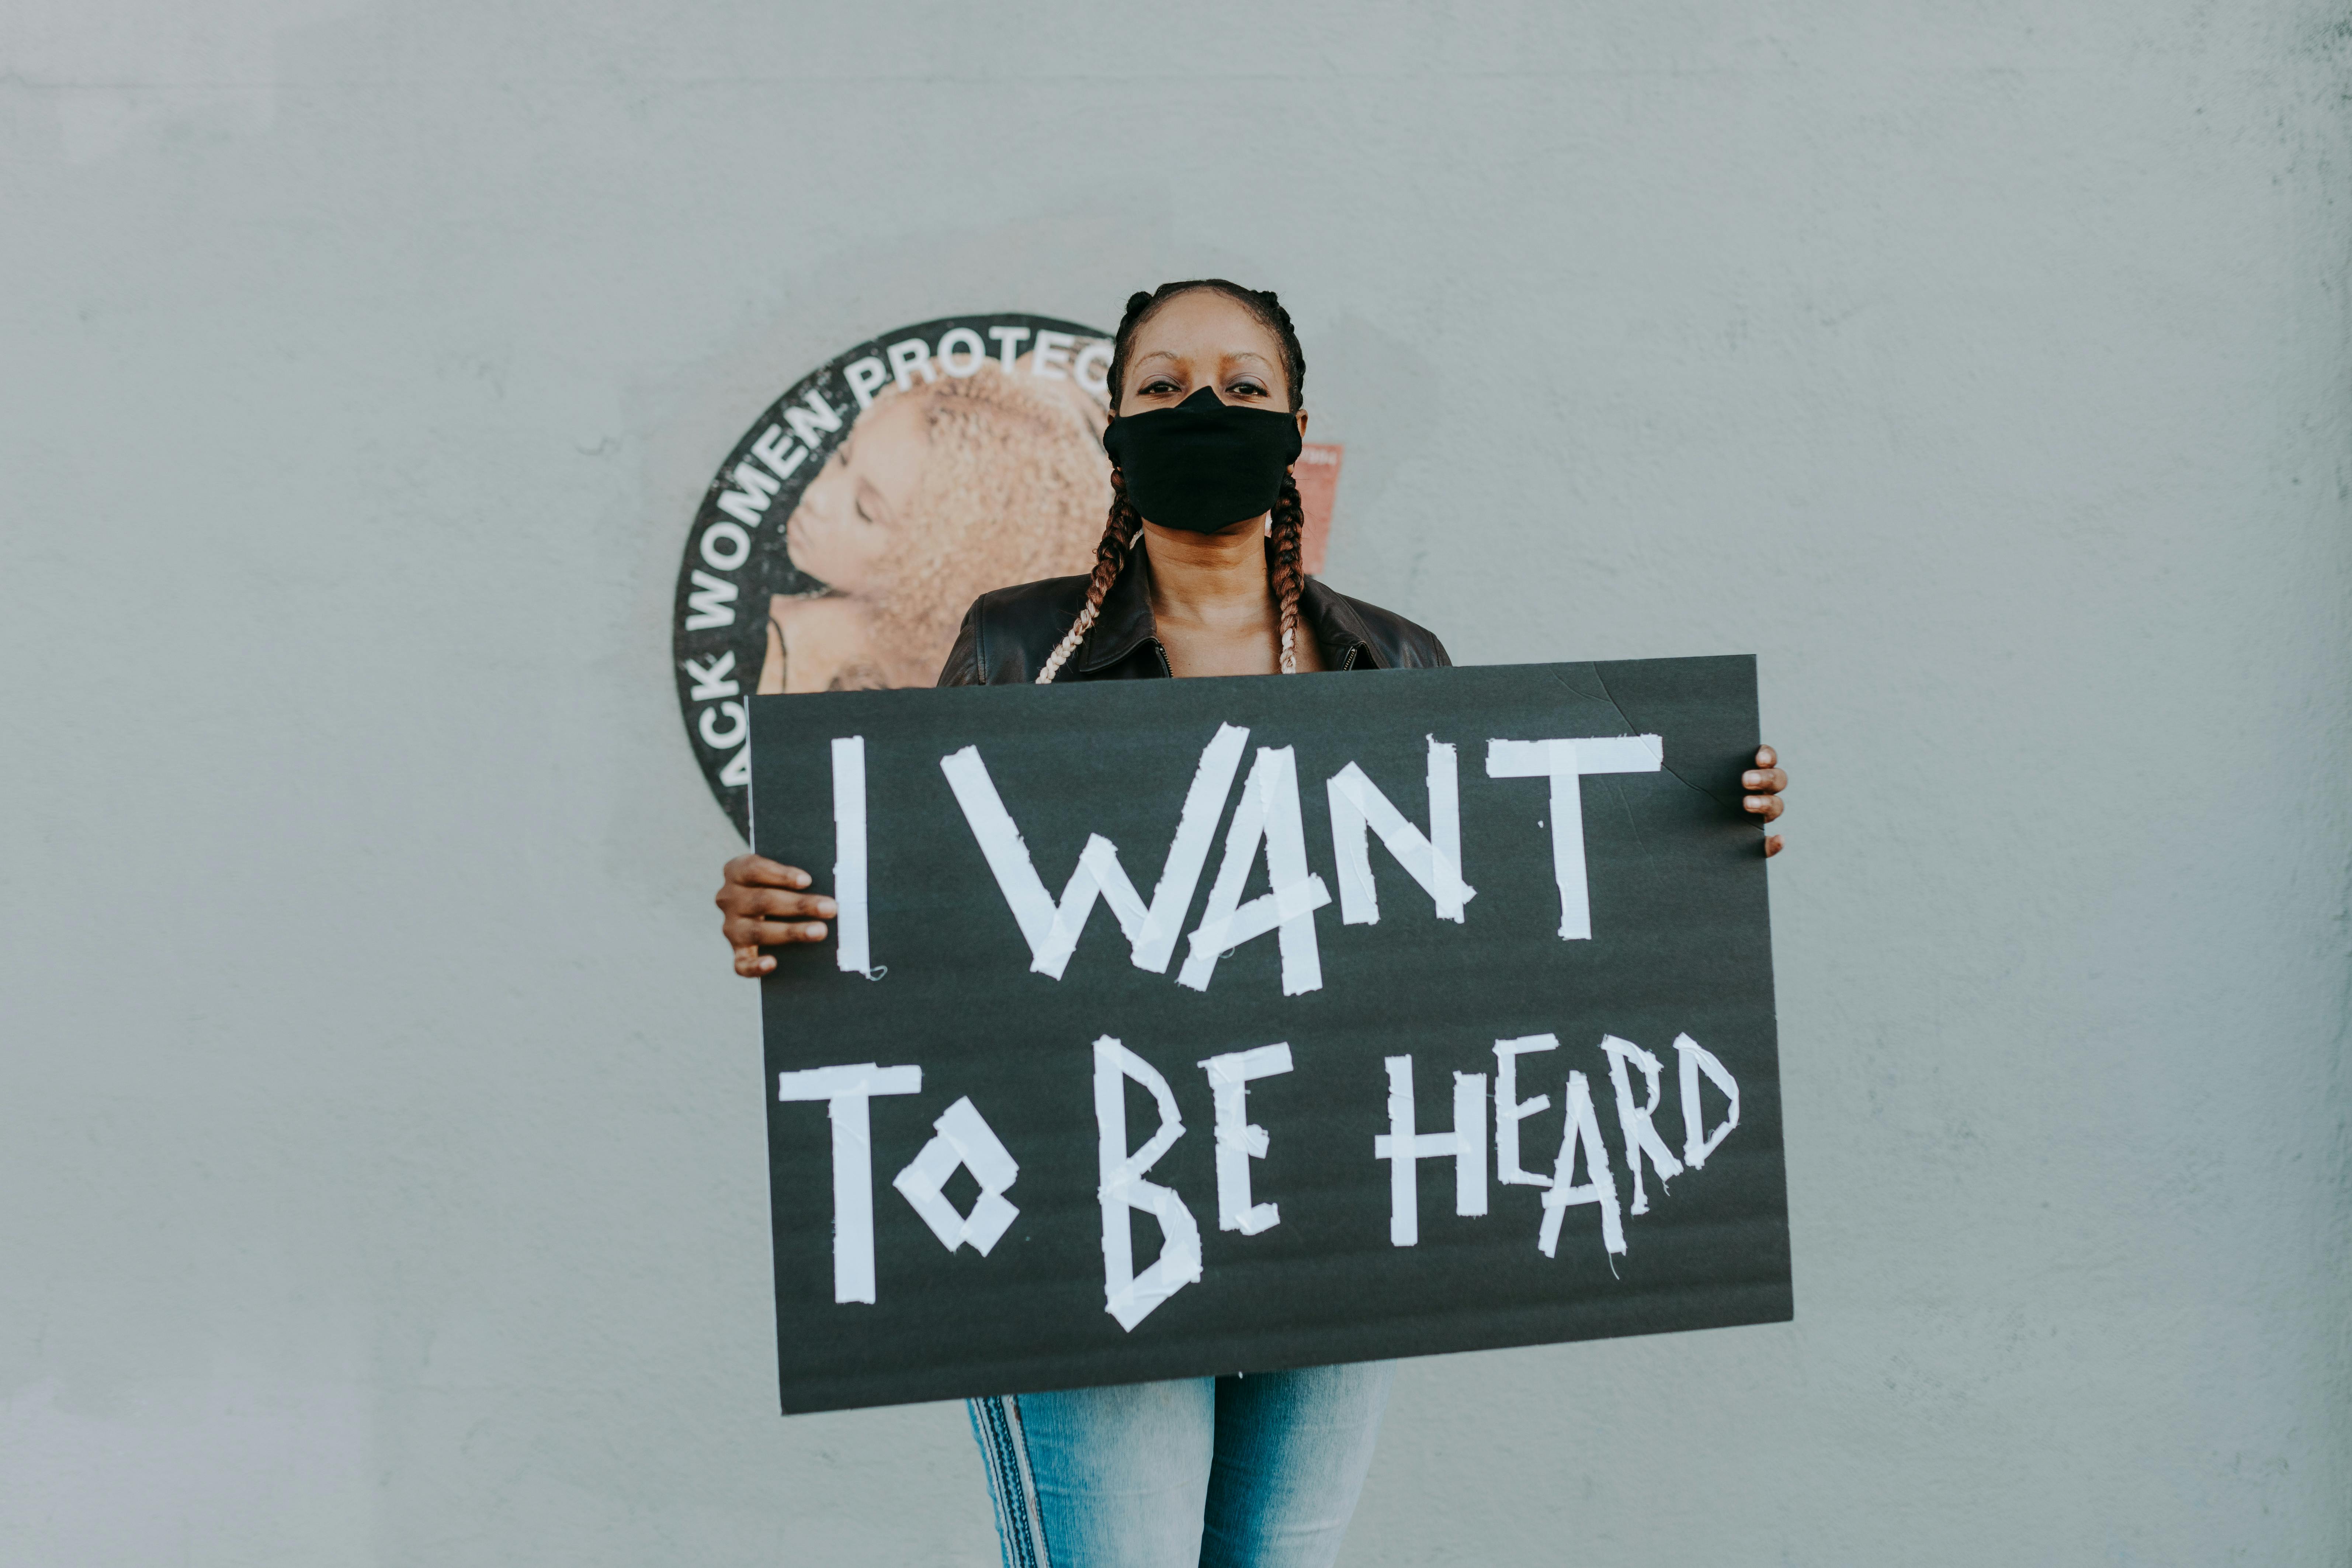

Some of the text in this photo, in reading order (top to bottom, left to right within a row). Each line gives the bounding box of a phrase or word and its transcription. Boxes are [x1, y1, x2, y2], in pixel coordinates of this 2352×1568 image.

[686, 390, 843, 630] WOMEN
[832, 722, 1663, 996] I WANT
[780, 1033, 1739, 1332] TO BE HEARD
